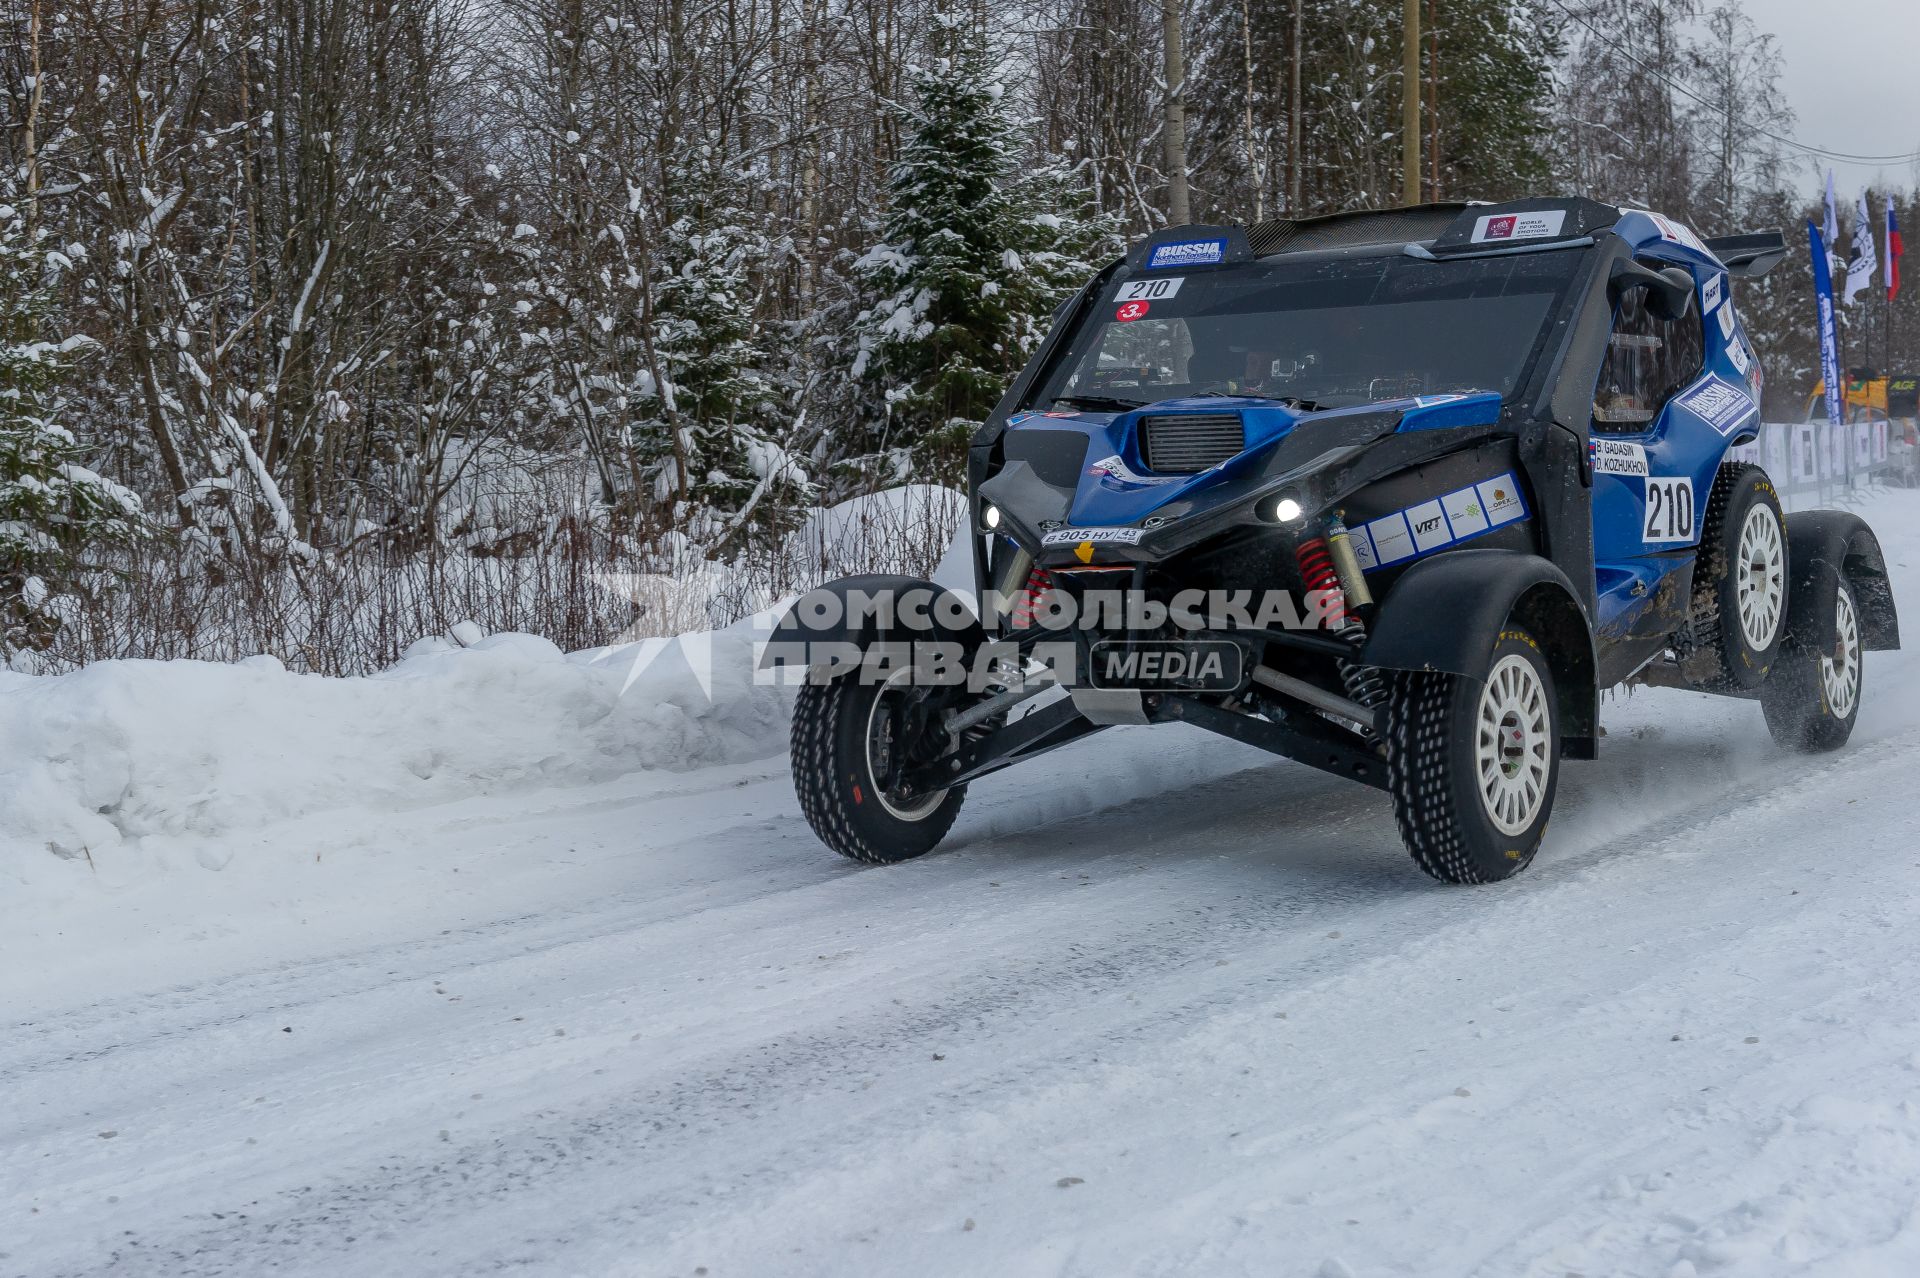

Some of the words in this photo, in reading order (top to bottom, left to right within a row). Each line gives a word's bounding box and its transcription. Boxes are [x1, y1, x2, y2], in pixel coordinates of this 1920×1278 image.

[1159, 243, 1220, 257] RUSSIA
[1127, 279, 1171, 299] 210
[1687, 382, 1731, 411] RUSSIA
[1596, 440, 1604, 453] B.
[1605, 442, 1635, 456] GADASIN
[1596, 457, 1603, 470] D.
[1604, 458, 1647, 473] KOZHUKHOV
[1492, 497, 1511, 508] OPEX
[1647, 482, 1692, 538] 210
[1415, 516, 1442, 534] VRT
[1058, 530, 1091, 541] 905
